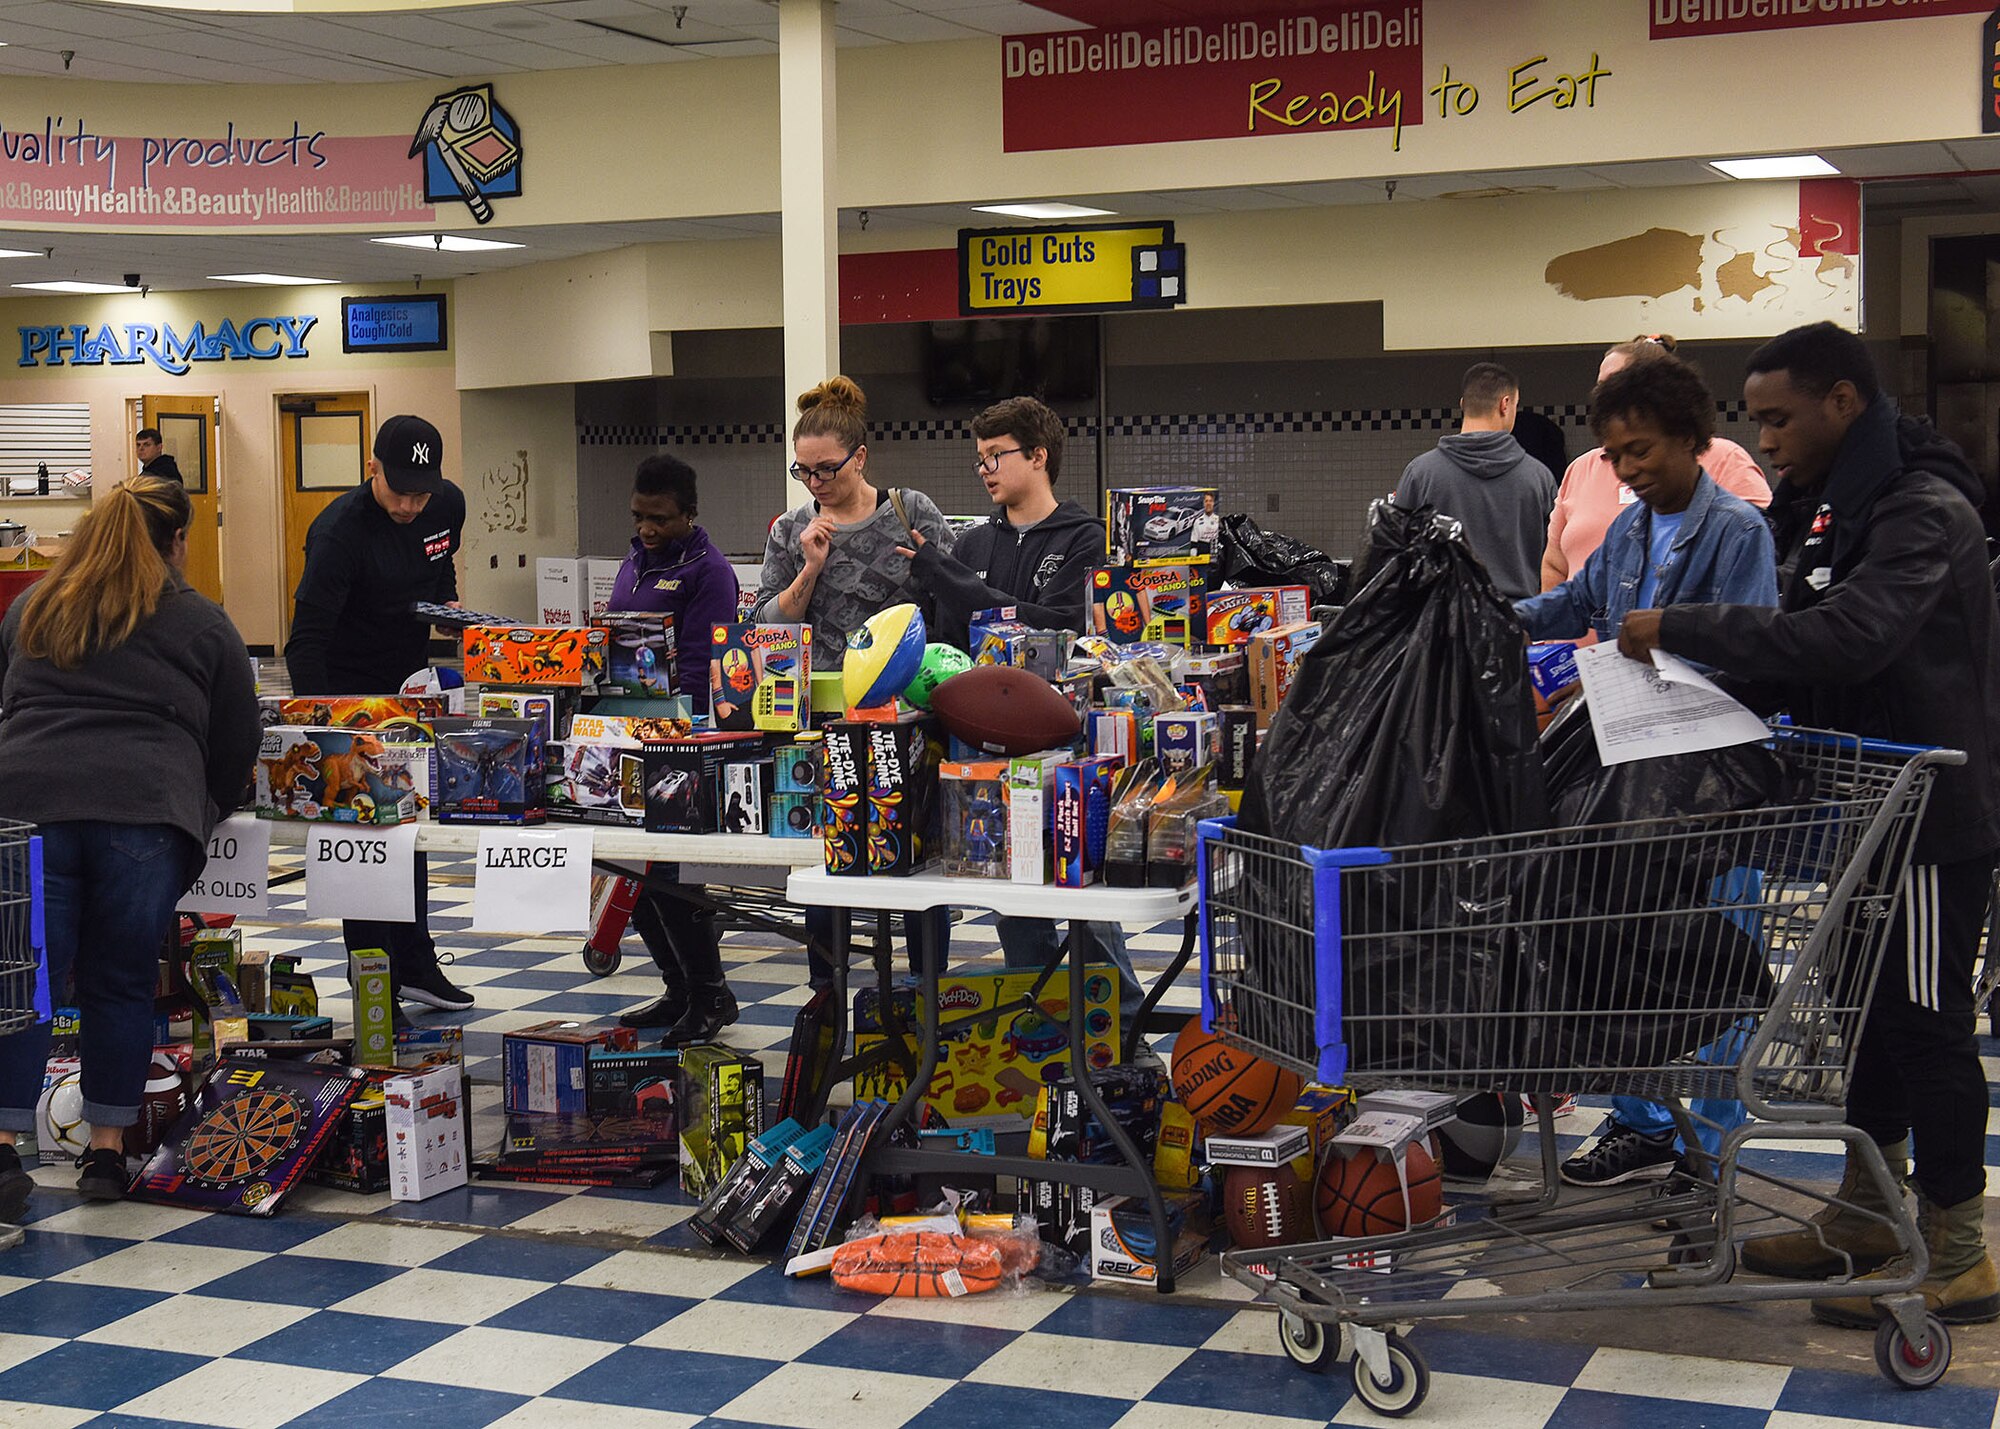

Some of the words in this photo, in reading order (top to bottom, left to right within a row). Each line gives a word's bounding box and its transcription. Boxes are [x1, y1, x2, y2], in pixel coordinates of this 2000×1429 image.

[1249, 70, 1403, 152] Ready
[1429, 64, 1479, 117] to
[1508, 53, 1612, 114] Eat
[0, 116, 117, 193] uality
[143, 121, 328, 192] products
[981, 238, 1031, 267] Cold
[1043, 235, 1095, 265] Cuts
[980, 272, 1041, 305] Trays
[351, 306, 408, 324] Analgesics
[351, 321, 412, 341] Cough/Cold
[17, 315, 318, 375] PHARMACY
[1130, 572, 1178, 588] COBRA
[1157, 580, 1187, 593] BANDS
[1129, 616, 1137, 626] 5
[745, 630, 790, 645] COBRA
[770, 640, 797, 651] BANDS
[742, 676, 750, 686] 5
[573, 727, 605, 738] WARS
[574, 718, 604, 728] STAR
[825, 733, 848, 791] MACHINE
[837, 733, 859, 786] TIE-DYE
[870, 731, 892, 789] MACHINE
[882, 731, 903, 785] TIE-DYE
[209, 837, 238, 860] 10
[317, 839, 387, 864] BOYS
[485, 847, 568, 868] LARGE
[1014, 841, 1039, 858] CLOCK
[1021, 861, 1034, 878] KIT
[211, 881, 257, 899] OLDS
[235, 1049, 267, 1059] STAR
[626, 1060, 648, 1068] IMAGE
[304, 1108, 342, 1154] MAGNETIC
[1244, 1186, 1257, 1231] Wilson
[1100, 1261, 1141, 1274] REV
